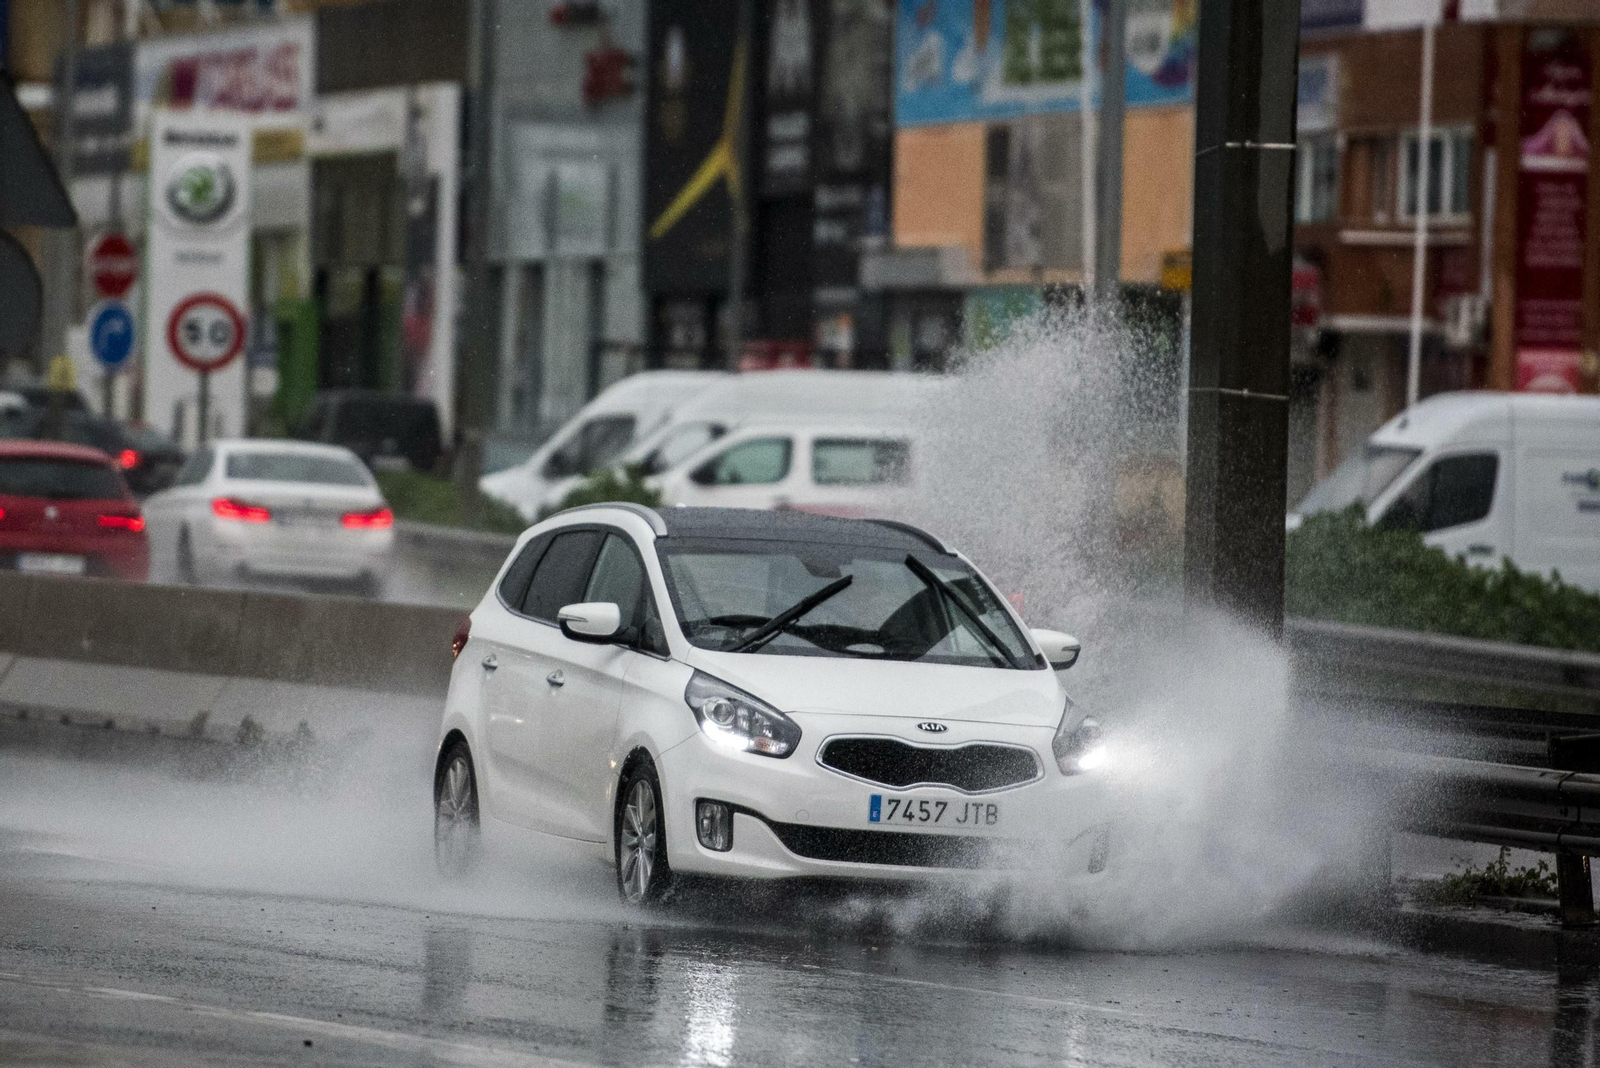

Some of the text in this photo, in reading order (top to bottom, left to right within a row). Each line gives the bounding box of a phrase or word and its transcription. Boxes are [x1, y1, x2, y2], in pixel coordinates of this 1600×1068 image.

[183, 318, 232, 347] 50
[920, 722, 946, 732] KIA
[887, 799, 998, 825] 7457 JTB
